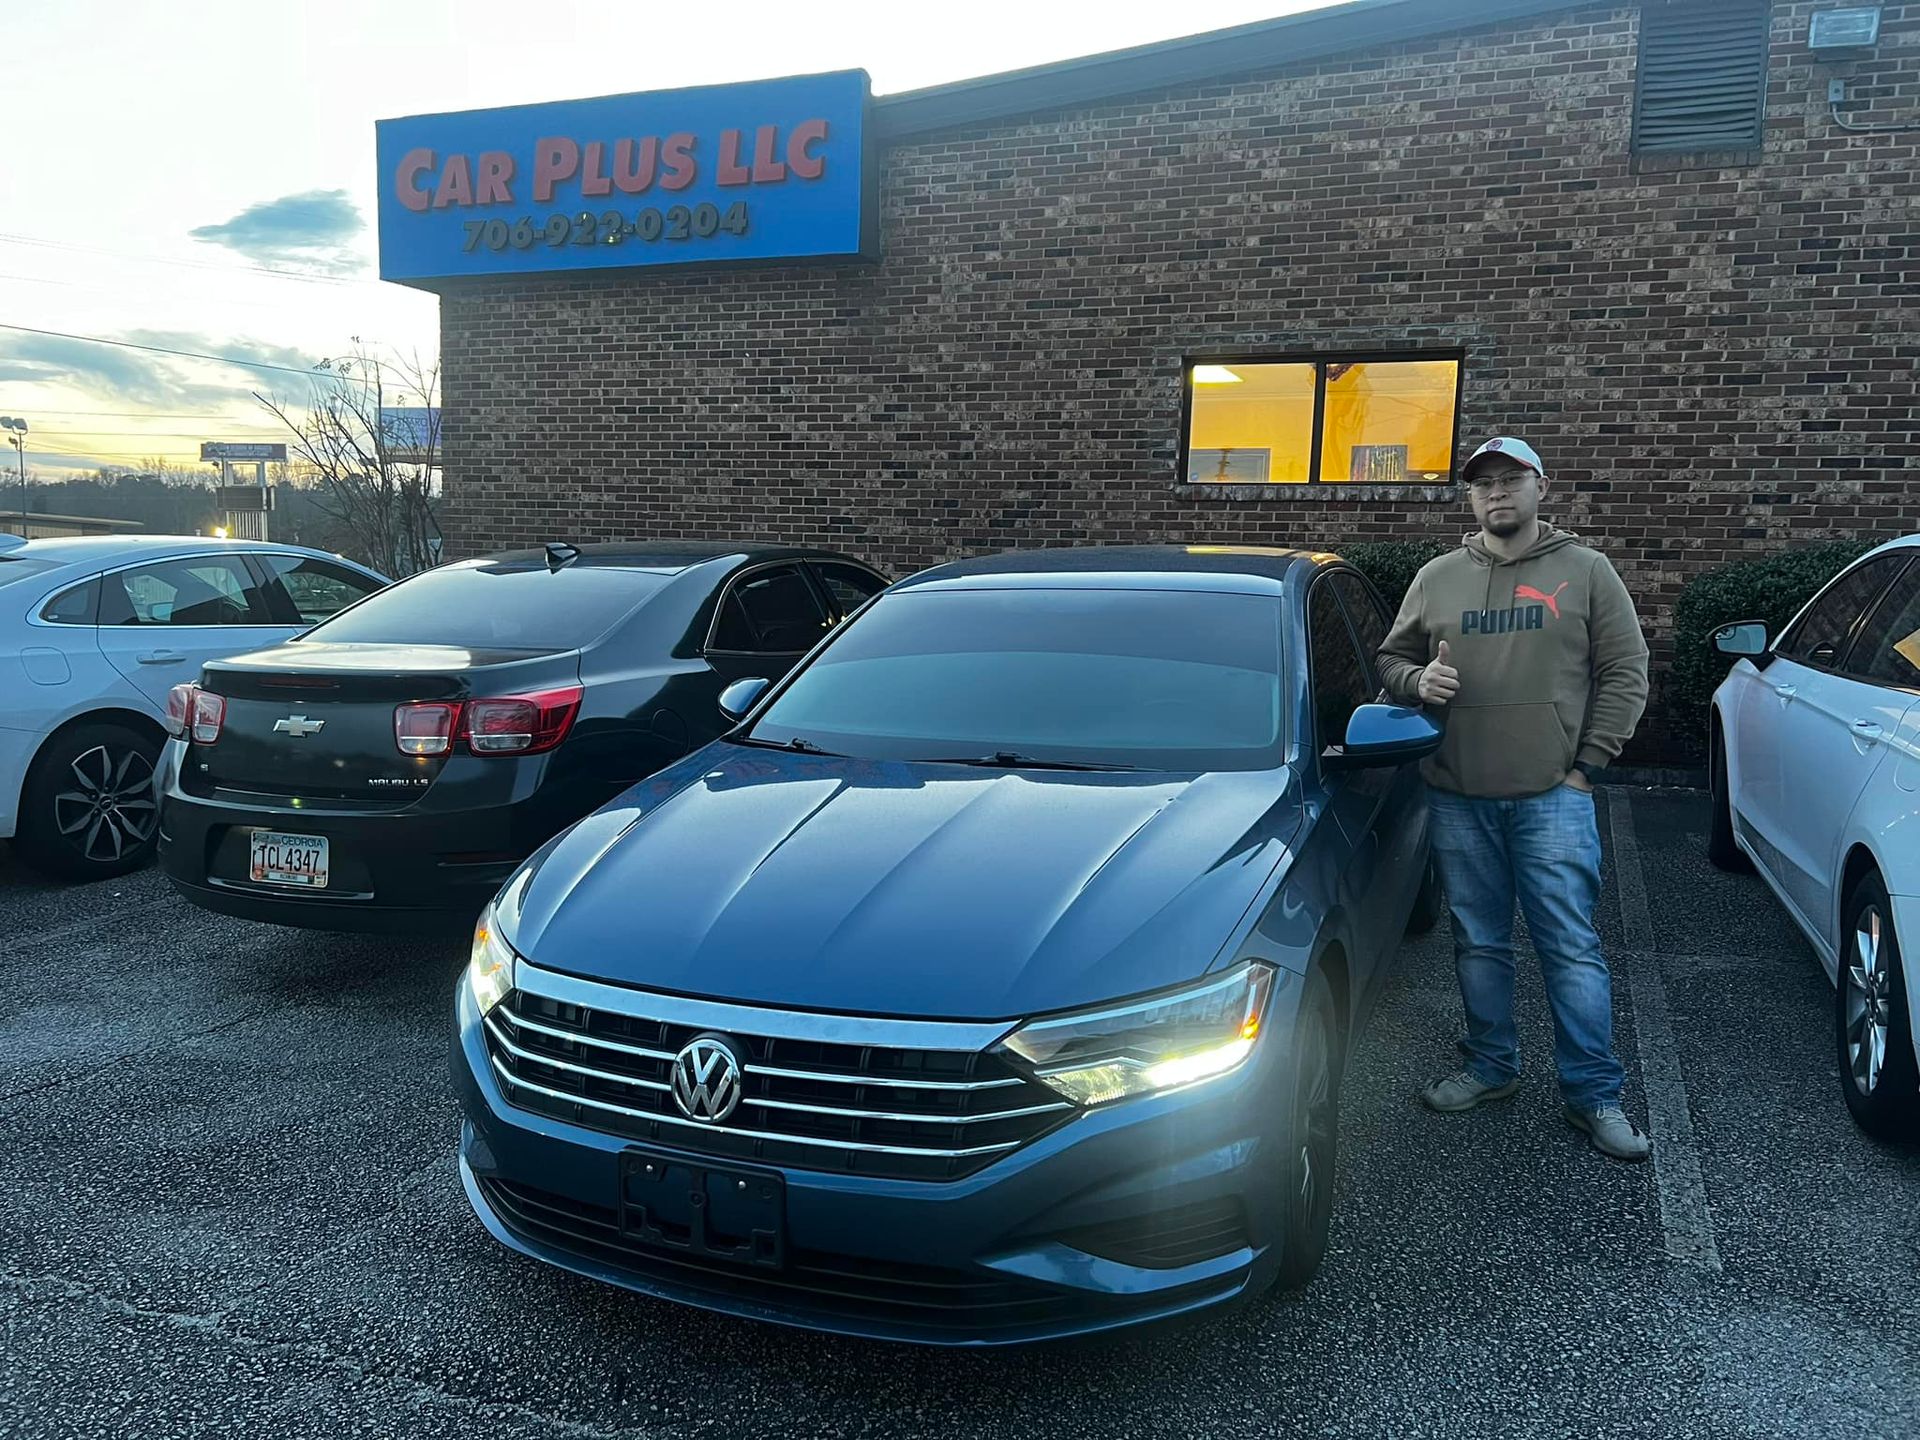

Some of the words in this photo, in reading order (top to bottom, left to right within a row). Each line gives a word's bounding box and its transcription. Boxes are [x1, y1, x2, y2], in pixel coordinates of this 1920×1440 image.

[396, 148, 514, 211] CAR
[533, 133, 697, 201] PLUS
[716, 119, 829, 186] LLC
[462, 201, 748, 254] 706-922-0204
[1462, 604, 1543, 635] PUMA
[368, 778, 409, 787] MALIBU
[413, 778, 429, 787] LS
[281, 835, 323, 847] GEORGIA
[259, 844, 320, 874] TCL4347
